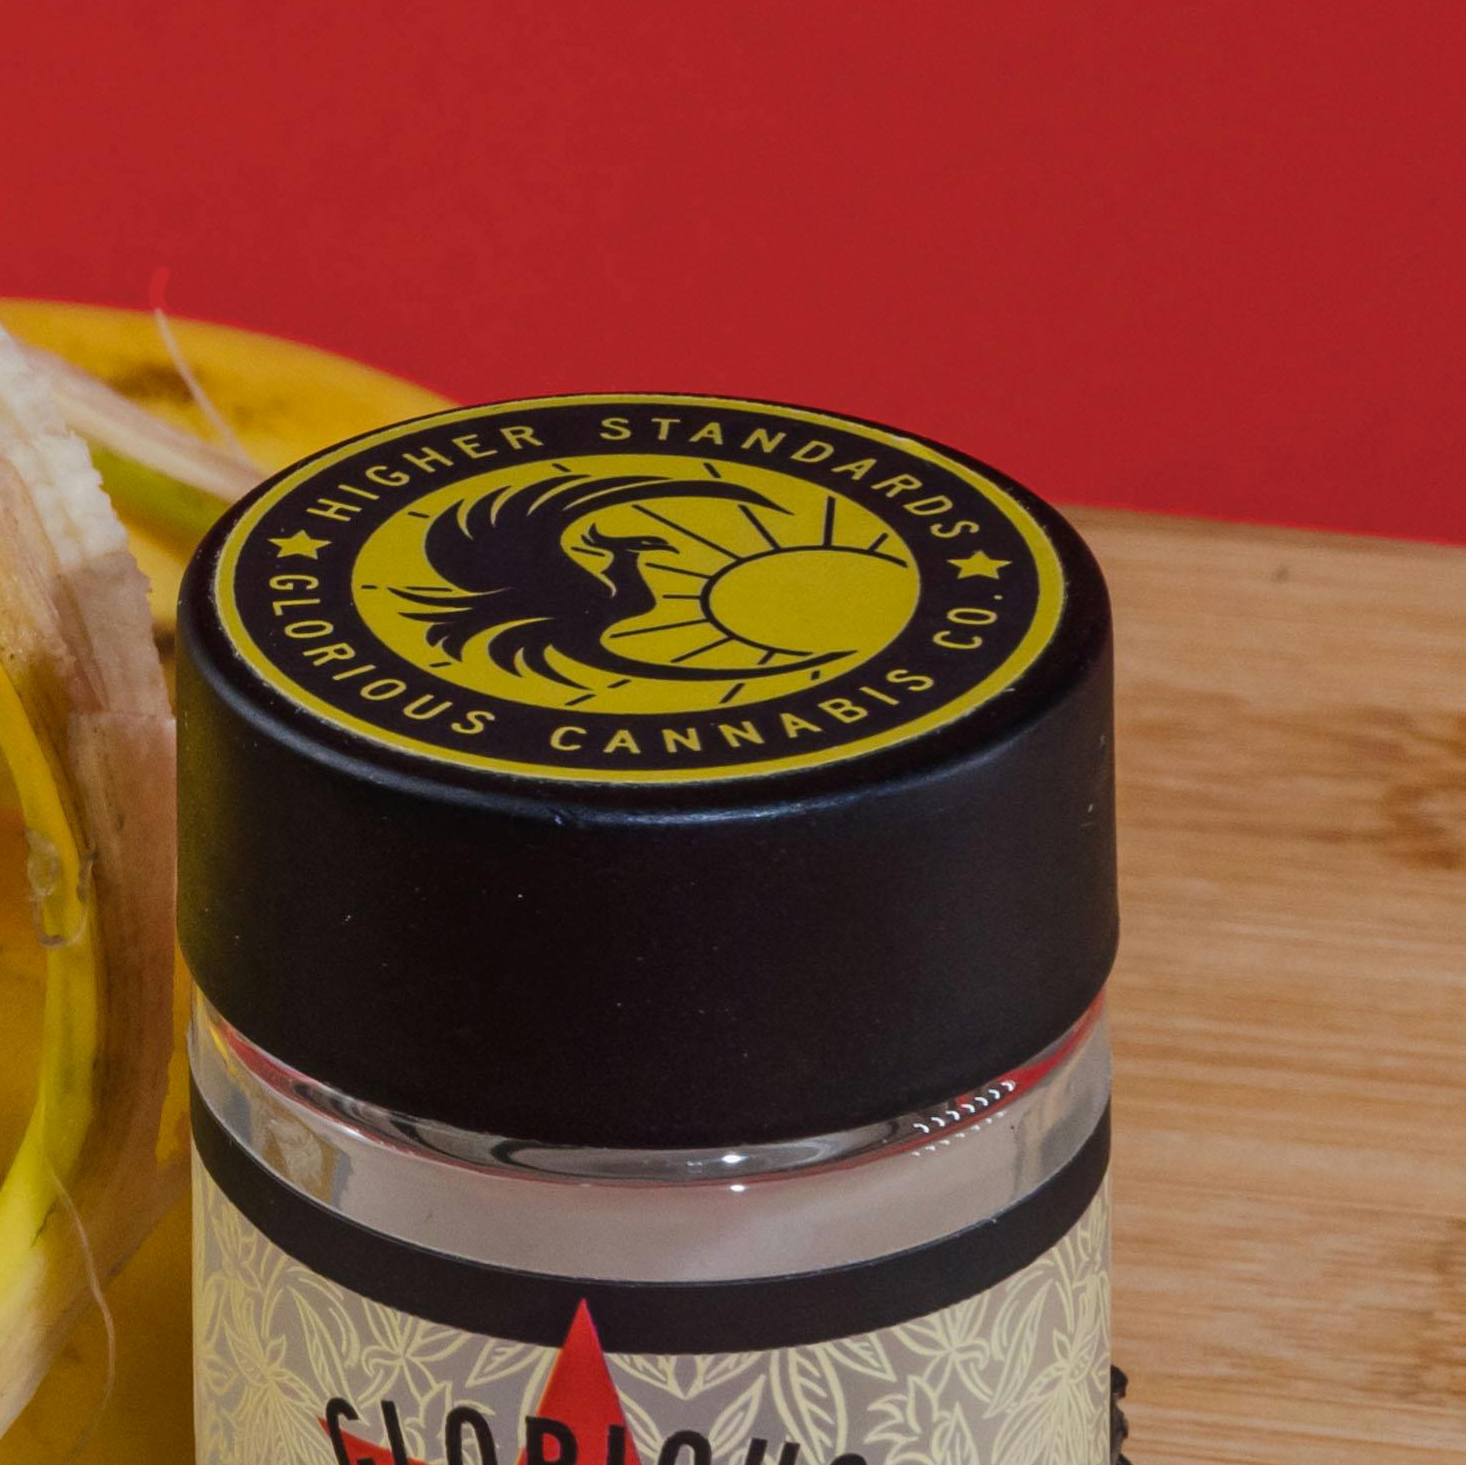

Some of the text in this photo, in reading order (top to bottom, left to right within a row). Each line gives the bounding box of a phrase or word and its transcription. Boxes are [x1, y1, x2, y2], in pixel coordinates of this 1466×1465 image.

[307, 415, 980, 540] HIGHER STANDARDS
[269, 572, 1003, 755] GLORIOUS CANNABIS CO.
